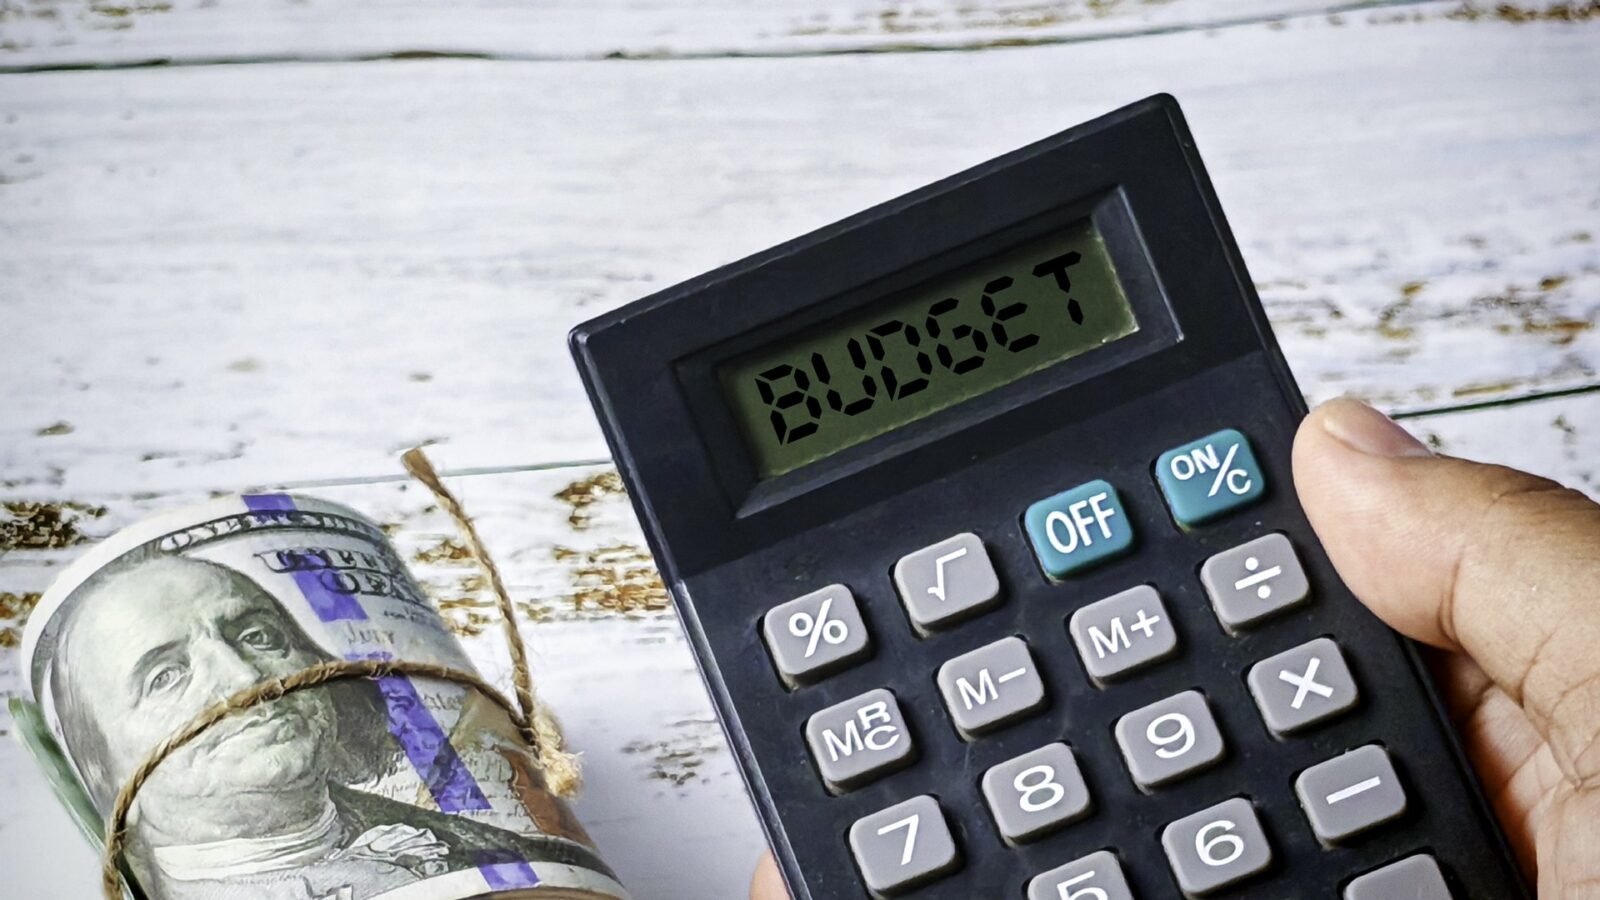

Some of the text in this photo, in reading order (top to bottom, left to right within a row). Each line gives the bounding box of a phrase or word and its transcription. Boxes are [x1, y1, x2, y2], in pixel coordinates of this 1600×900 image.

[755, 251, 1082, 446] BUDGET
[1045, 493, 1115, 554] OFF
[788, 597, 849, 659] %
[1087, 608, 1161, 659] M+
[1146, 712, 1196, 759] 9
[1013, 764, 1065, 813] 8
[876, 813, 920, 866] 7
[1195, 819, 1245, 867] 6
[1056, 870, 1108, 900] 5
